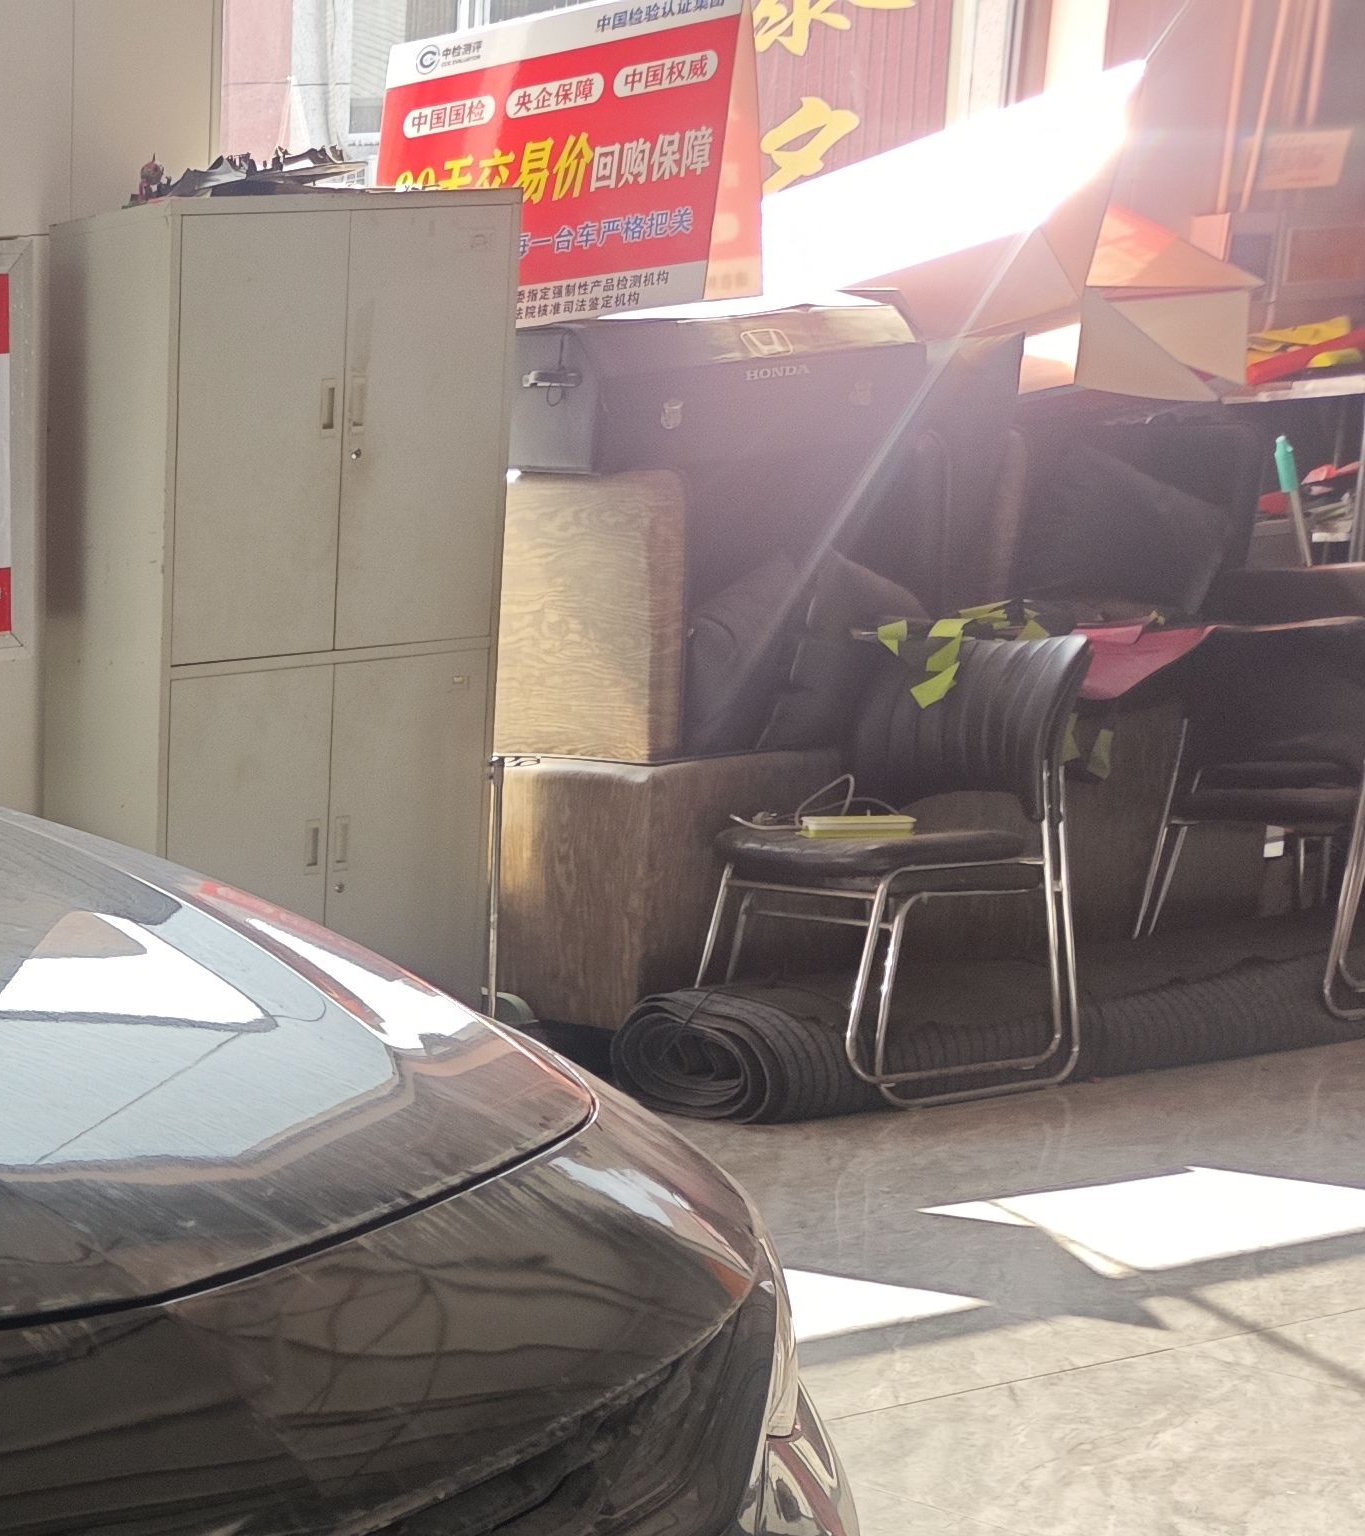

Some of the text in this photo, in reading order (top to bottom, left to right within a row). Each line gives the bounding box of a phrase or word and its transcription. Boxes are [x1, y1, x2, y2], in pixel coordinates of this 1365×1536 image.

[596, 0, 725, 33] 中国检验认证集团
[624, 54, 709, 92] 中国权威
[513, 78, 594, 116] 央企保障
[411, 100, 486, 134] 中国国检
[746, 364, 810, 381] HONDA
